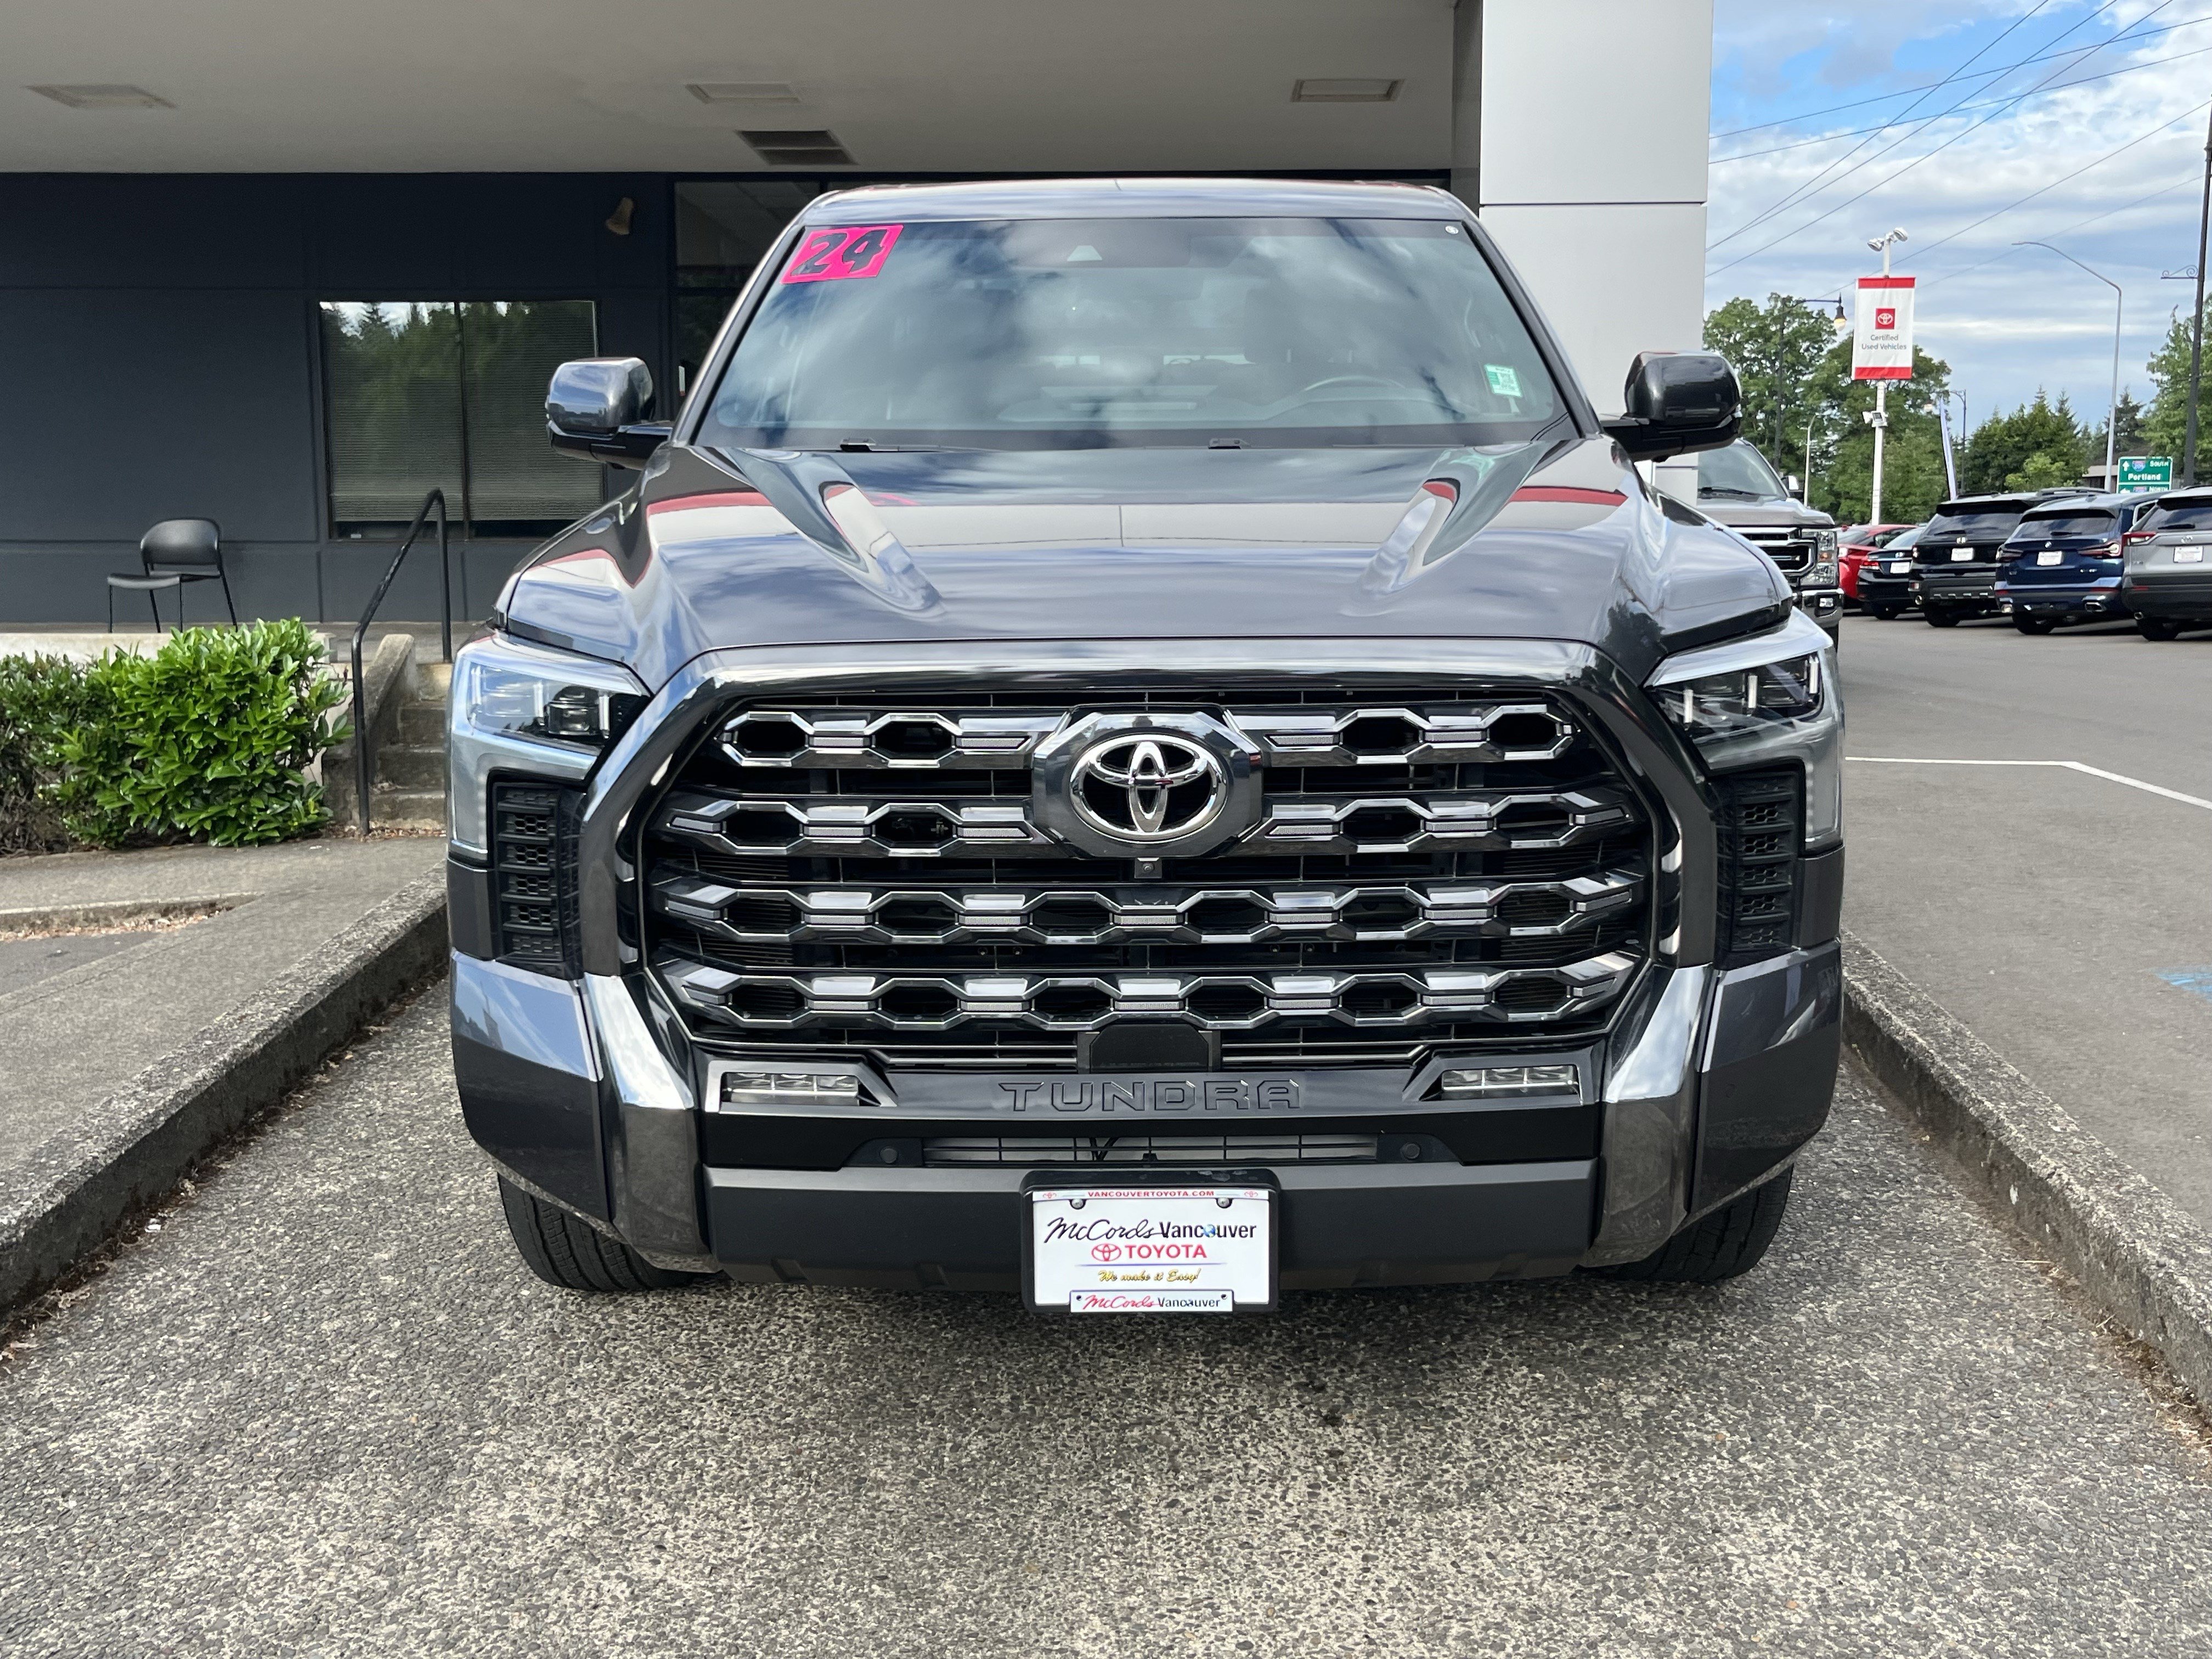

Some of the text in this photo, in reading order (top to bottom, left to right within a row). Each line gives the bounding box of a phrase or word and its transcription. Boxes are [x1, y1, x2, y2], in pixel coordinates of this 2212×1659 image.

[791, 229, 884, 276] 24
[998, 1079, 1300, 1111] TUNDRA
[1043, 1217, 1257, 1243] McCords Vancouver
[1125, 1244, 1207, 1259] TOYOTA
[1098, 1267, 1201, 1283] We make it Easy!
[1082, 1295, 1220, 1310] McCords Vancouver
